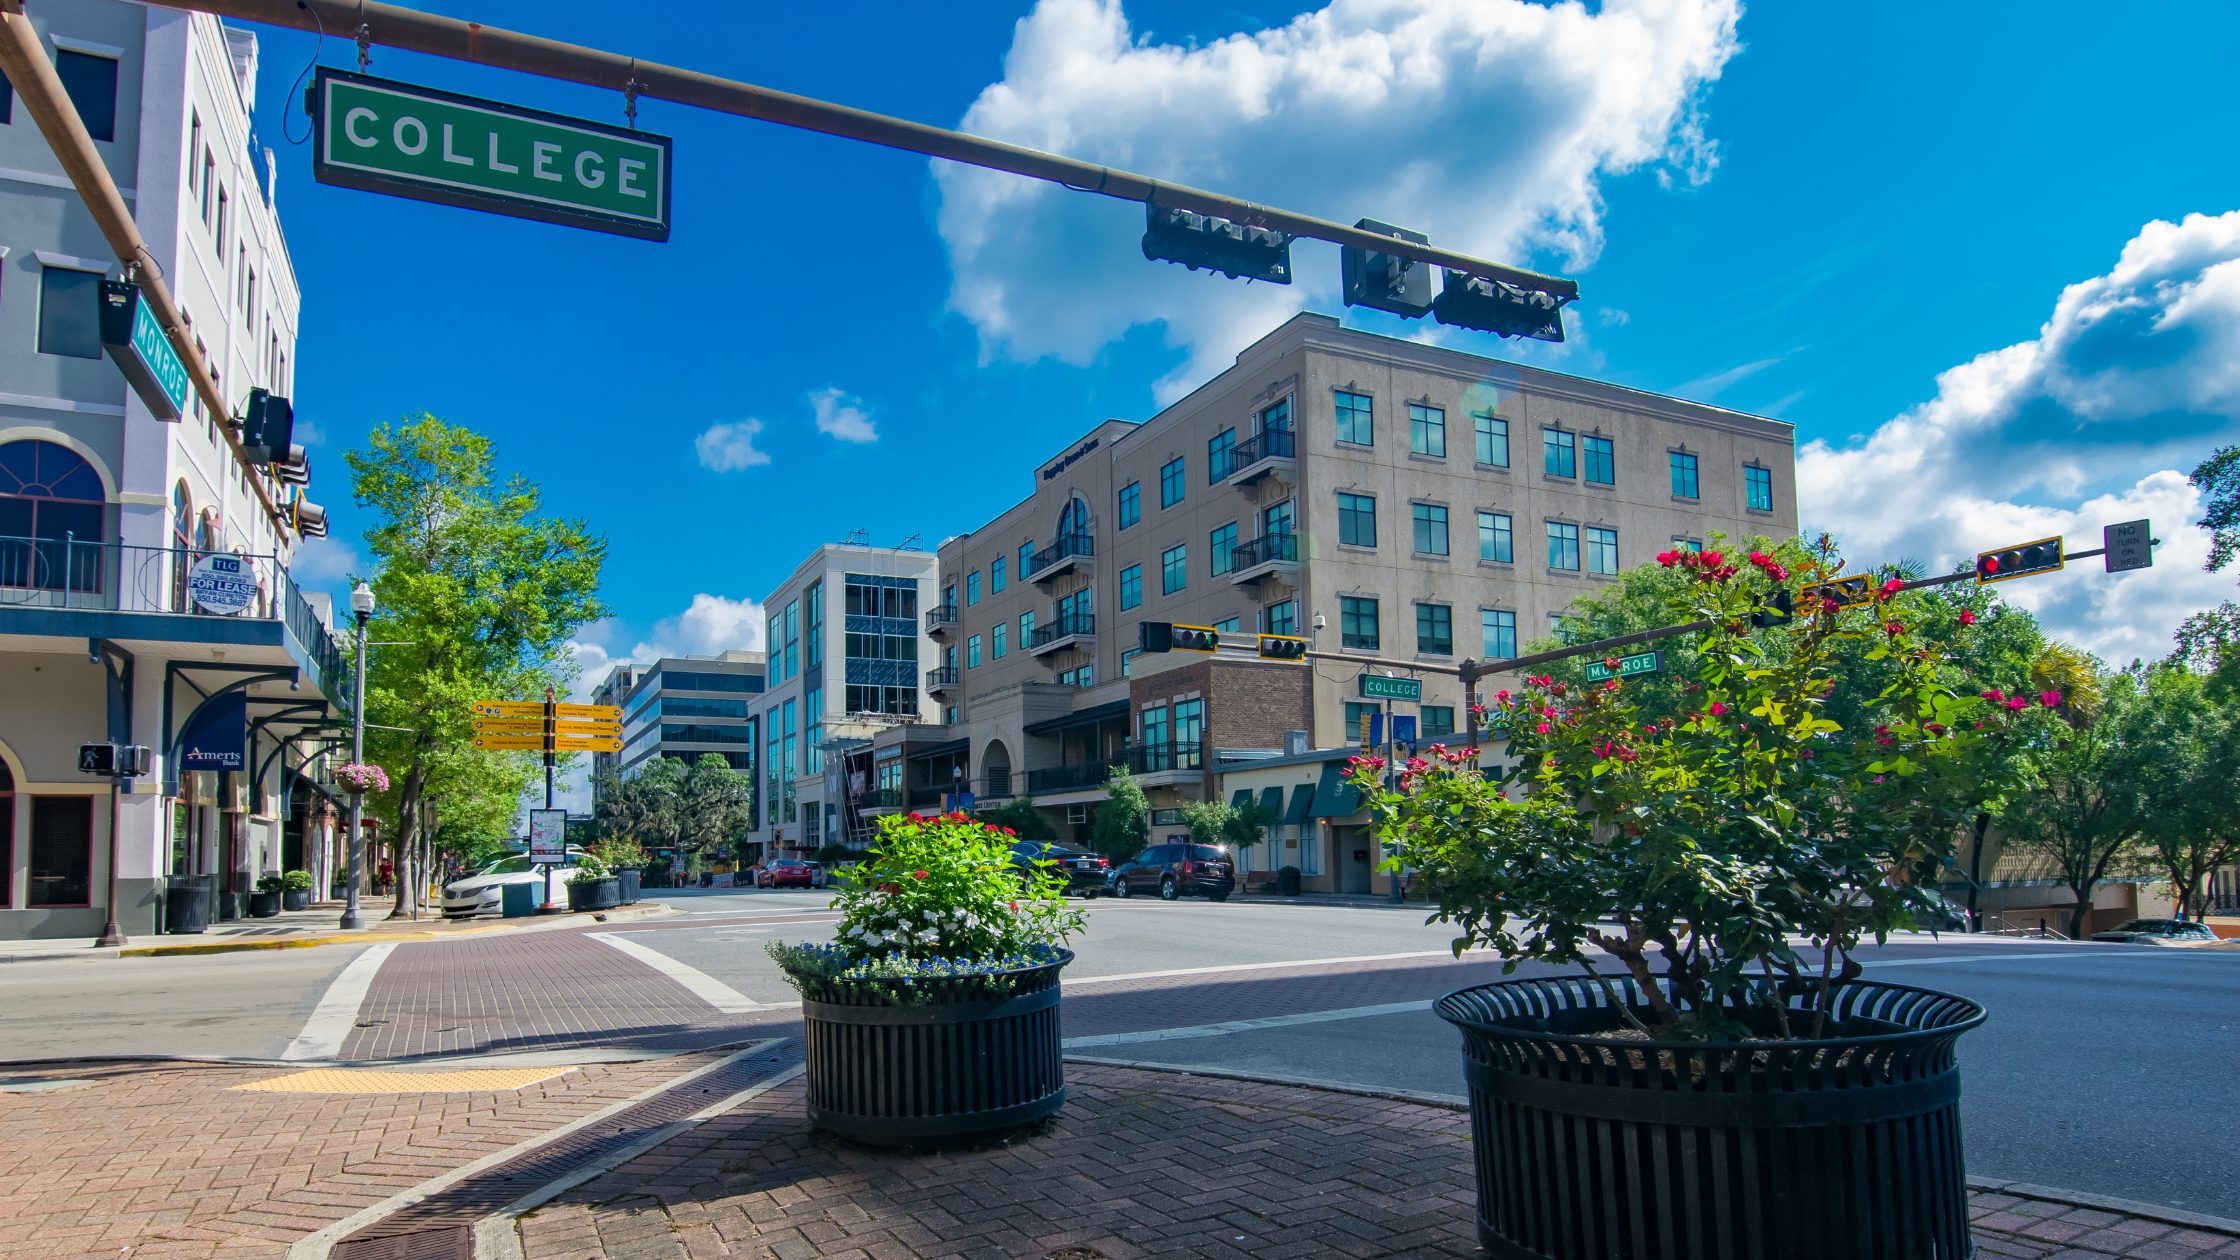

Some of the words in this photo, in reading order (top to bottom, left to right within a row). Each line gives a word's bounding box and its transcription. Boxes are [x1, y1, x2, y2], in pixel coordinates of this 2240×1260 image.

[344, 106, 647, 198] COLLEGE
[137, 311, 183, 401] MONROE
[2118, 526, 2136, 537] NO
[2117, 537, 2140, 548] TURN
[2121, 549, 2135, 557] ON
[214, 560, 238, 571] TLG
[2120, 557, 2139, 567] RED
[190, 577, 215, 590] FOR
[216, 580, 257, 595] LEASE
[195, 589, 217, 597] BRYAN
[217, 591, 248, 601] CURETON
[196, 595, 247, 607] 850.545.3687
[1590, 657, 1652, 678] MOROE
[1368, 681, 1418, 695] COLLEGE
[1361, 712, 1371, 759] ELCOME
[187, 746, 241, 760] Ameris
